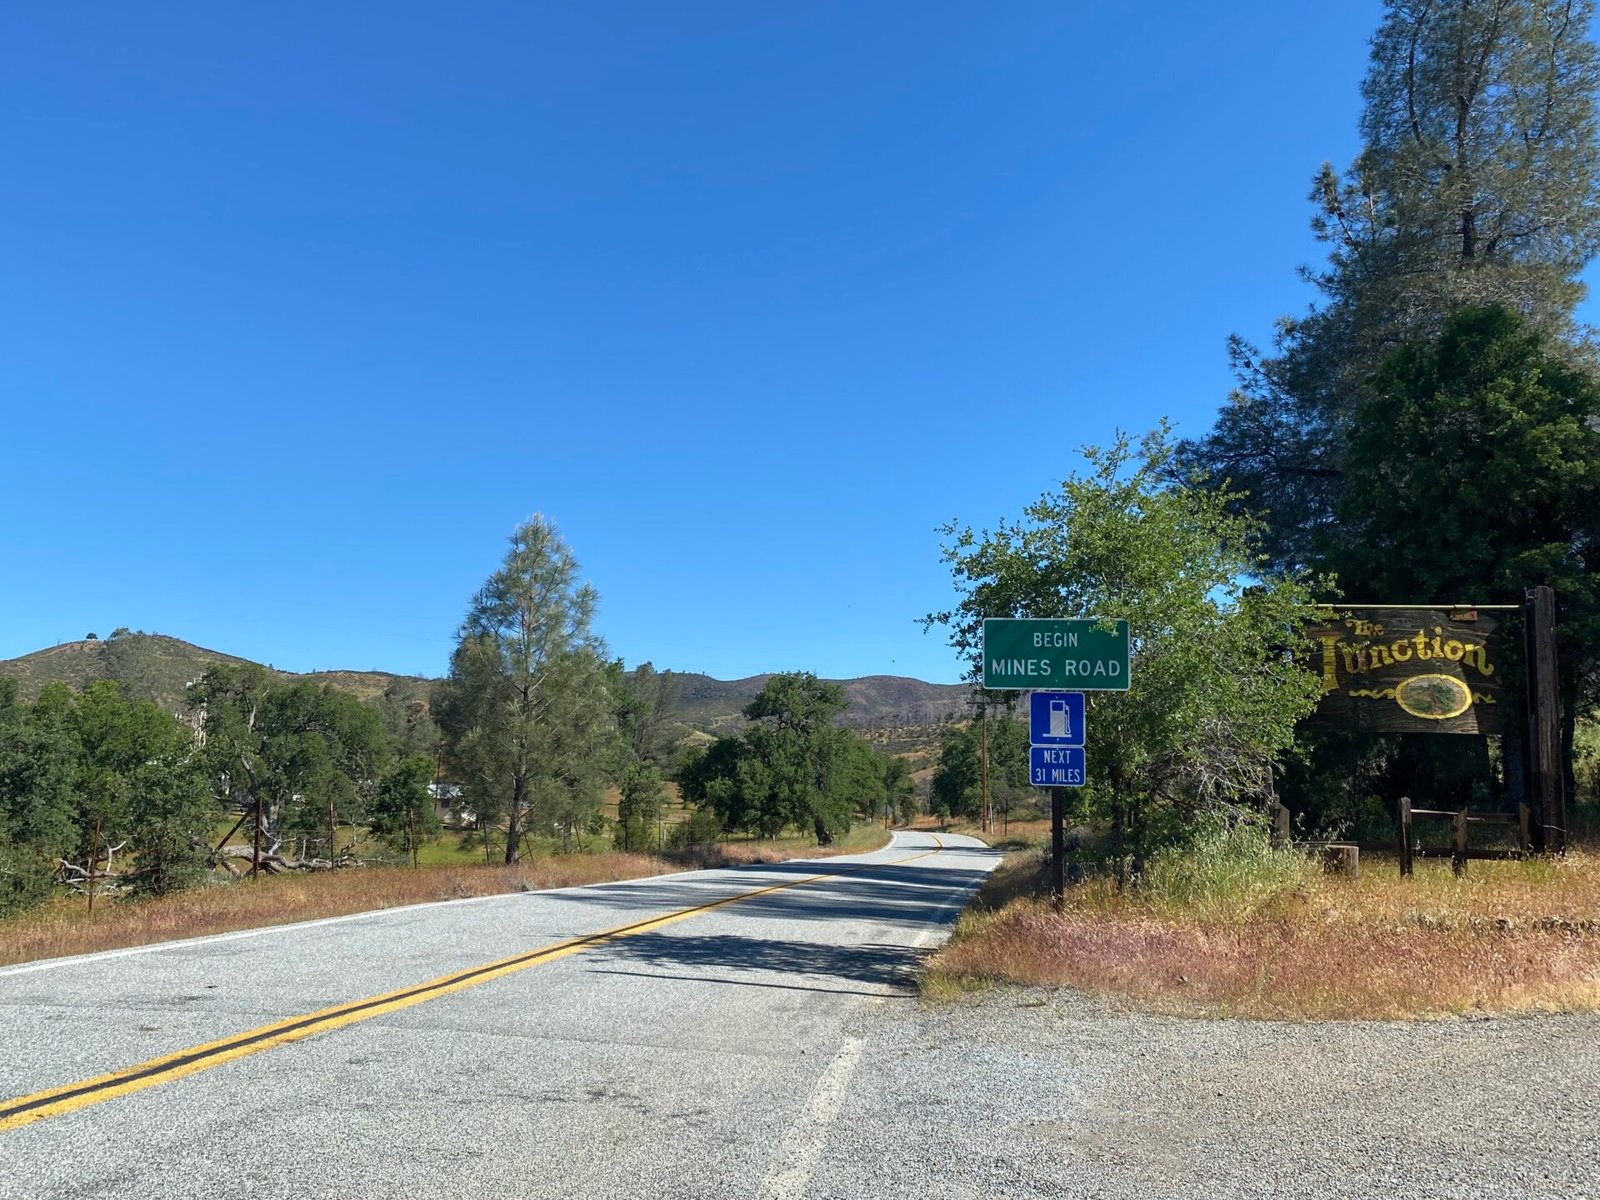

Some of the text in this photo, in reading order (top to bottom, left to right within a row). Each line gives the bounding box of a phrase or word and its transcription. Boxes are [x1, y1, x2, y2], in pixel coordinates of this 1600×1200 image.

[1345, 619, 1384, 636] The
[1033, 632, 1078, 648] BEGIN
[1319, 626, 1495, 692] Junction
[992, 659, 1121, 677] MINES ROAD
[1043, 750, 1071, 764] NEXT
[1035, 768, 1081, 783] 31 MILES
